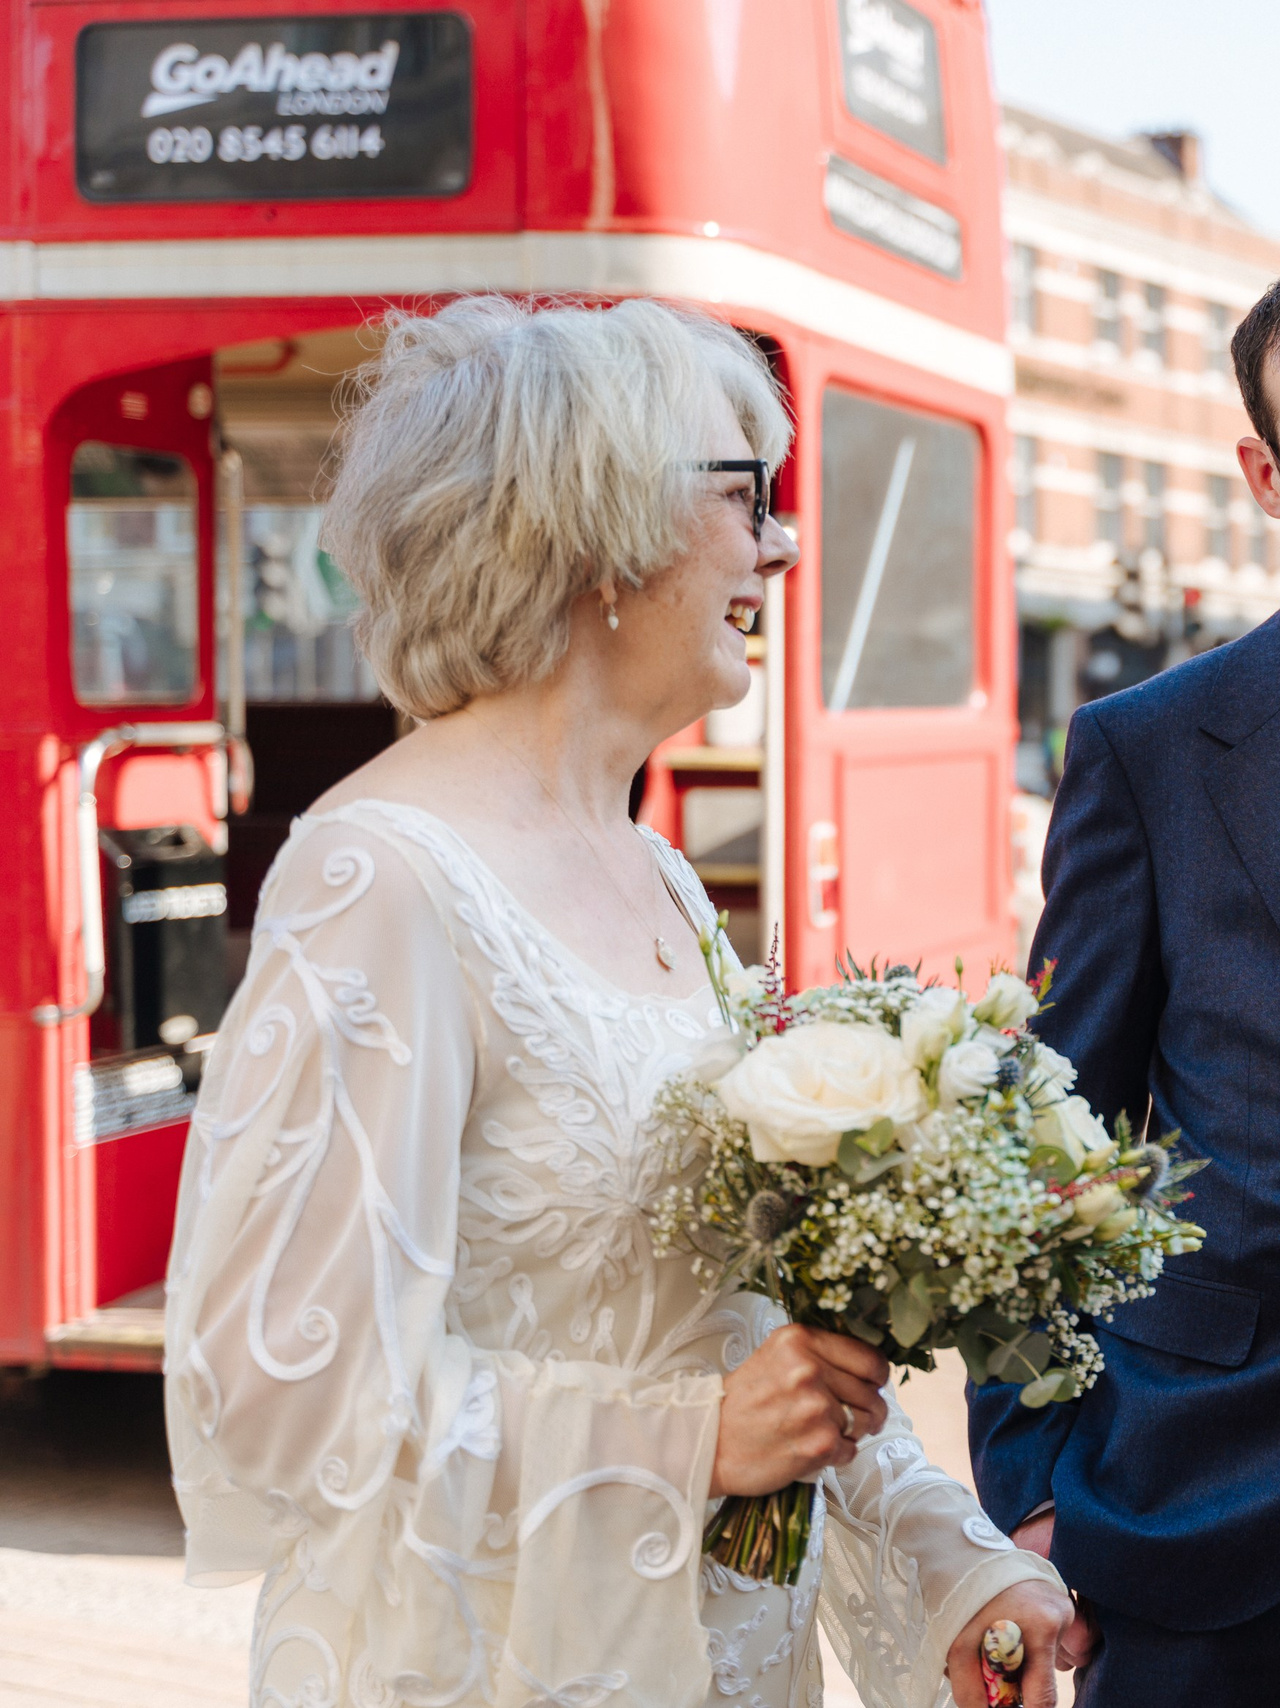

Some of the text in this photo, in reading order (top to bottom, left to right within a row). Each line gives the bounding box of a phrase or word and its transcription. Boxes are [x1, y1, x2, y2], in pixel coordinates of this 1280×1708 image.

[150, 41, 400, 95] GoAhead
[277, 90, 390, 116] LONDON
[147, 126, 214, 164] 020
[217, 124, 307, 162] 8545
